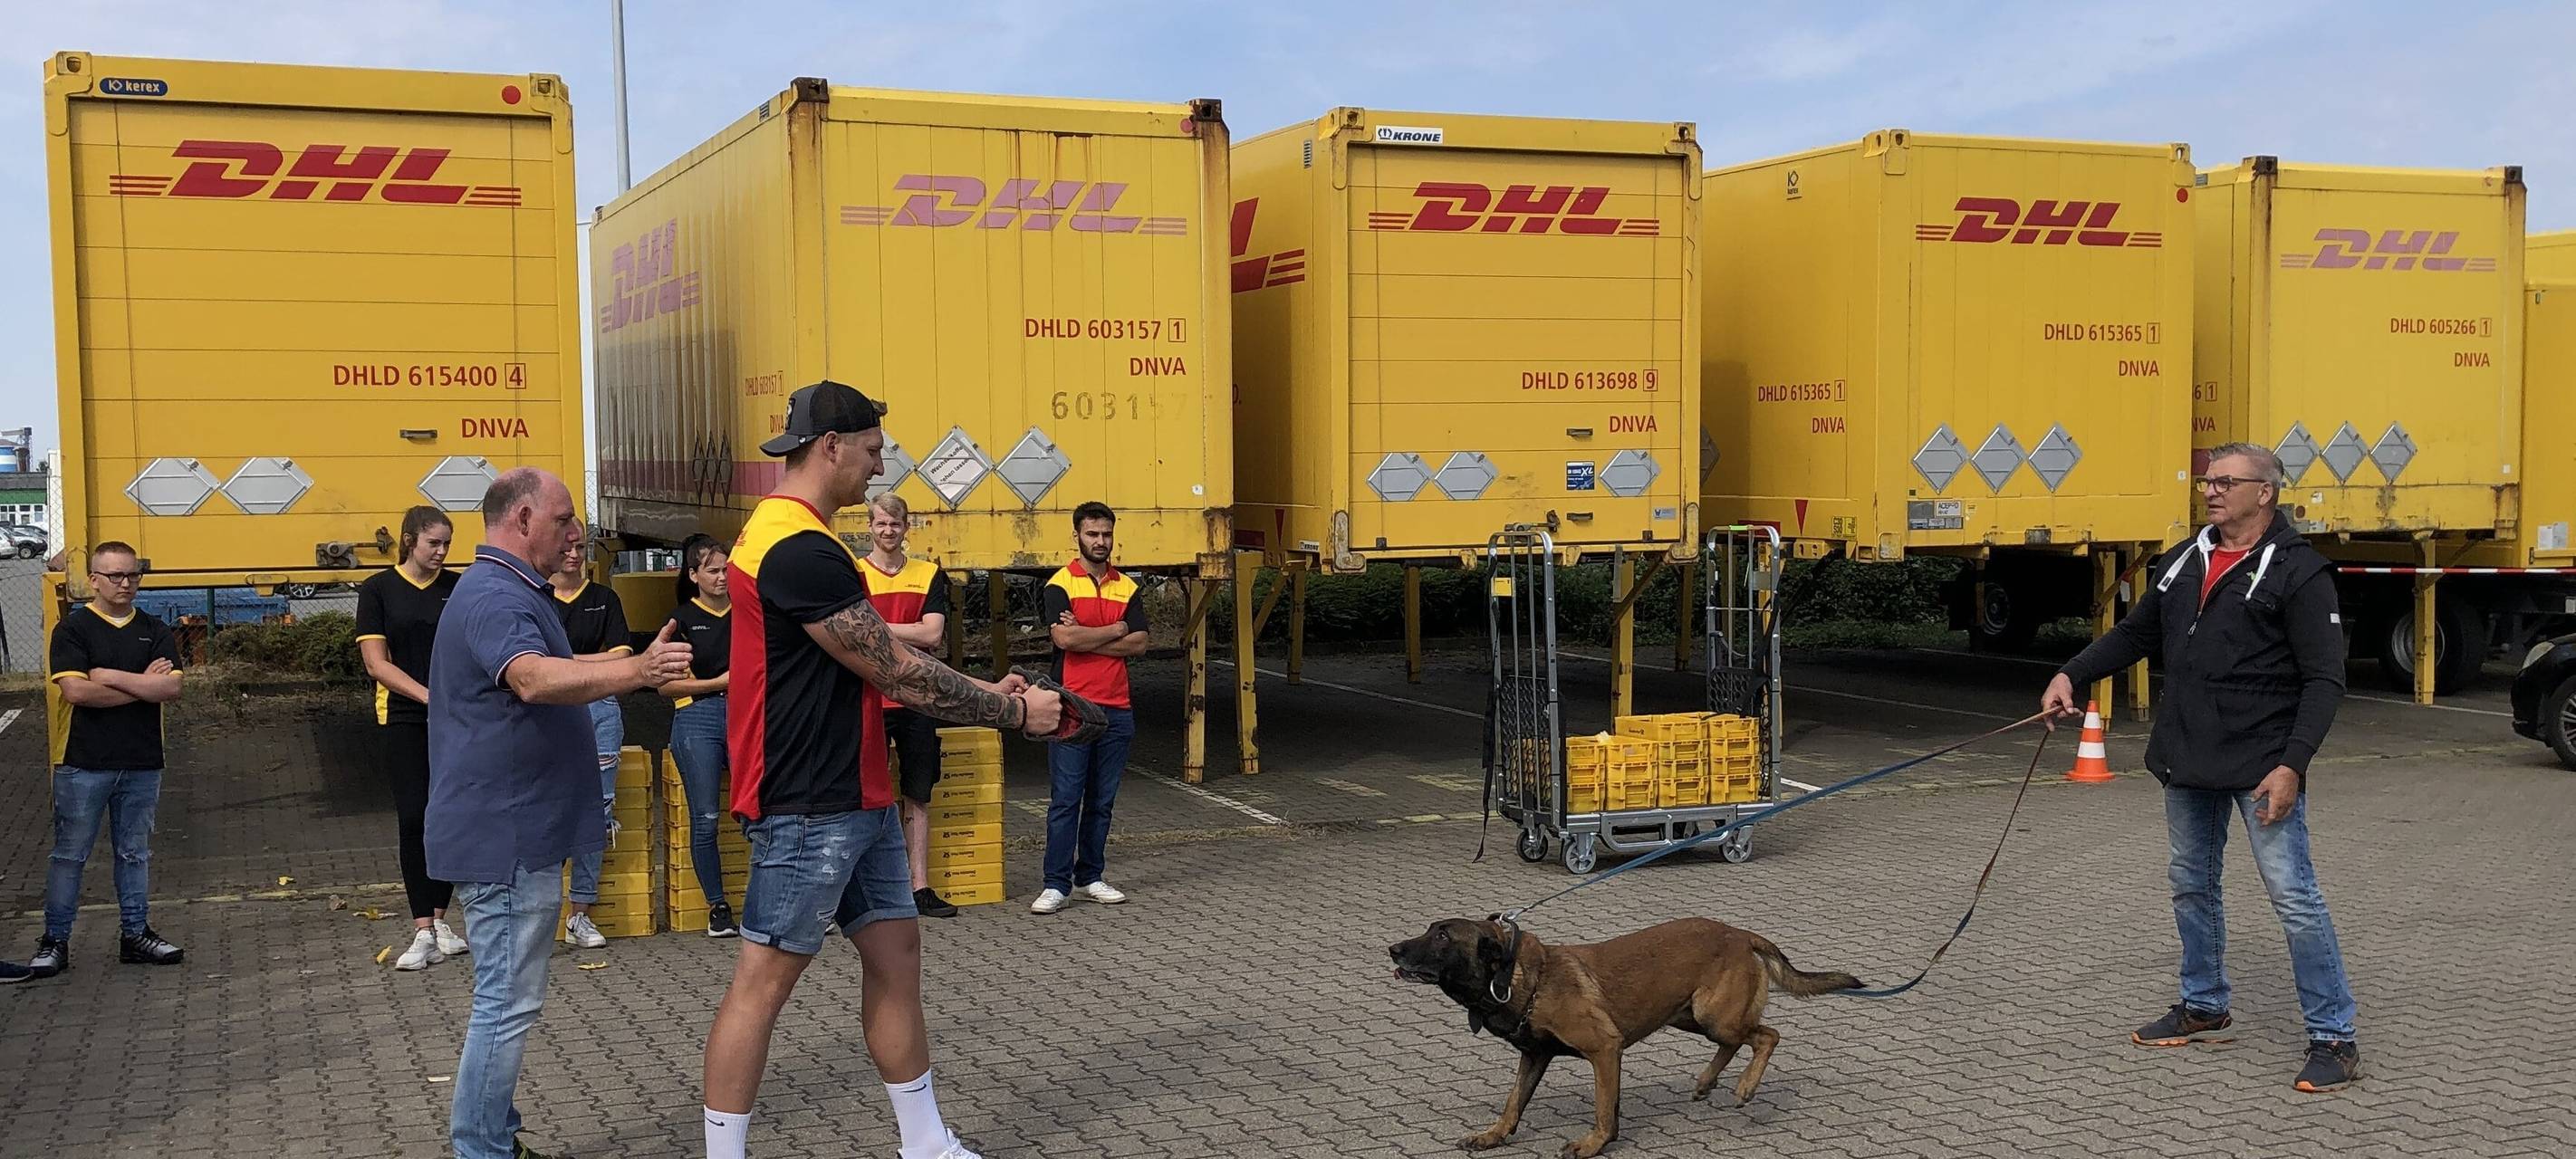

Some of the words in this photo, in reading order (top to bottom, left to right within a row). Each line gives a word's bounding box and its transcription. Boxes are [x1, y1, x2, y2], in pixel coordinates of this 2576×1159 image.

[125, 80, 160, 92] kerex
[1393, 131, 1441, 142] KRONE
[168, 140, 468, 204] DHL
[889, 175, 1141, 233] DHL
[1409, 182, 1620, 235] DHL
[1950, 197, 2129, 246] DHL
[2312, 228, 2468, 271] DHL
[611, 217, 684, 330] DHL
[1025, 319, 1081, 339] DHLD
[1087, 320, 1161, 340] 603157
[2044, 324, 2084, 340] DHLD
[2088, 324, 2142, 342] 615365
[2390, 318, 2426, 334] DHLD
[2429, 319, 2476, 335] 605266
[1129, 358, 1187, 377] DNVA
[2119, 359, 2160, 377] DNVA
[2454, 352, 2491, 368] DNVA
[333, 365, 400, 386] DHLD
[408, 365, 497, 387] 615400
[1522, 371, 1569, 390] DHLD
[1574, 371, 1638, 390] 613698
[1757, 385, 1787, 402] DHLD
[1790, 383, 1831, 401] 615365
[461, 417, 530, 438] DNVA
[1610, 415, 1658, 433] DNVA
[1812, 417, 1845, 434] DNVA
